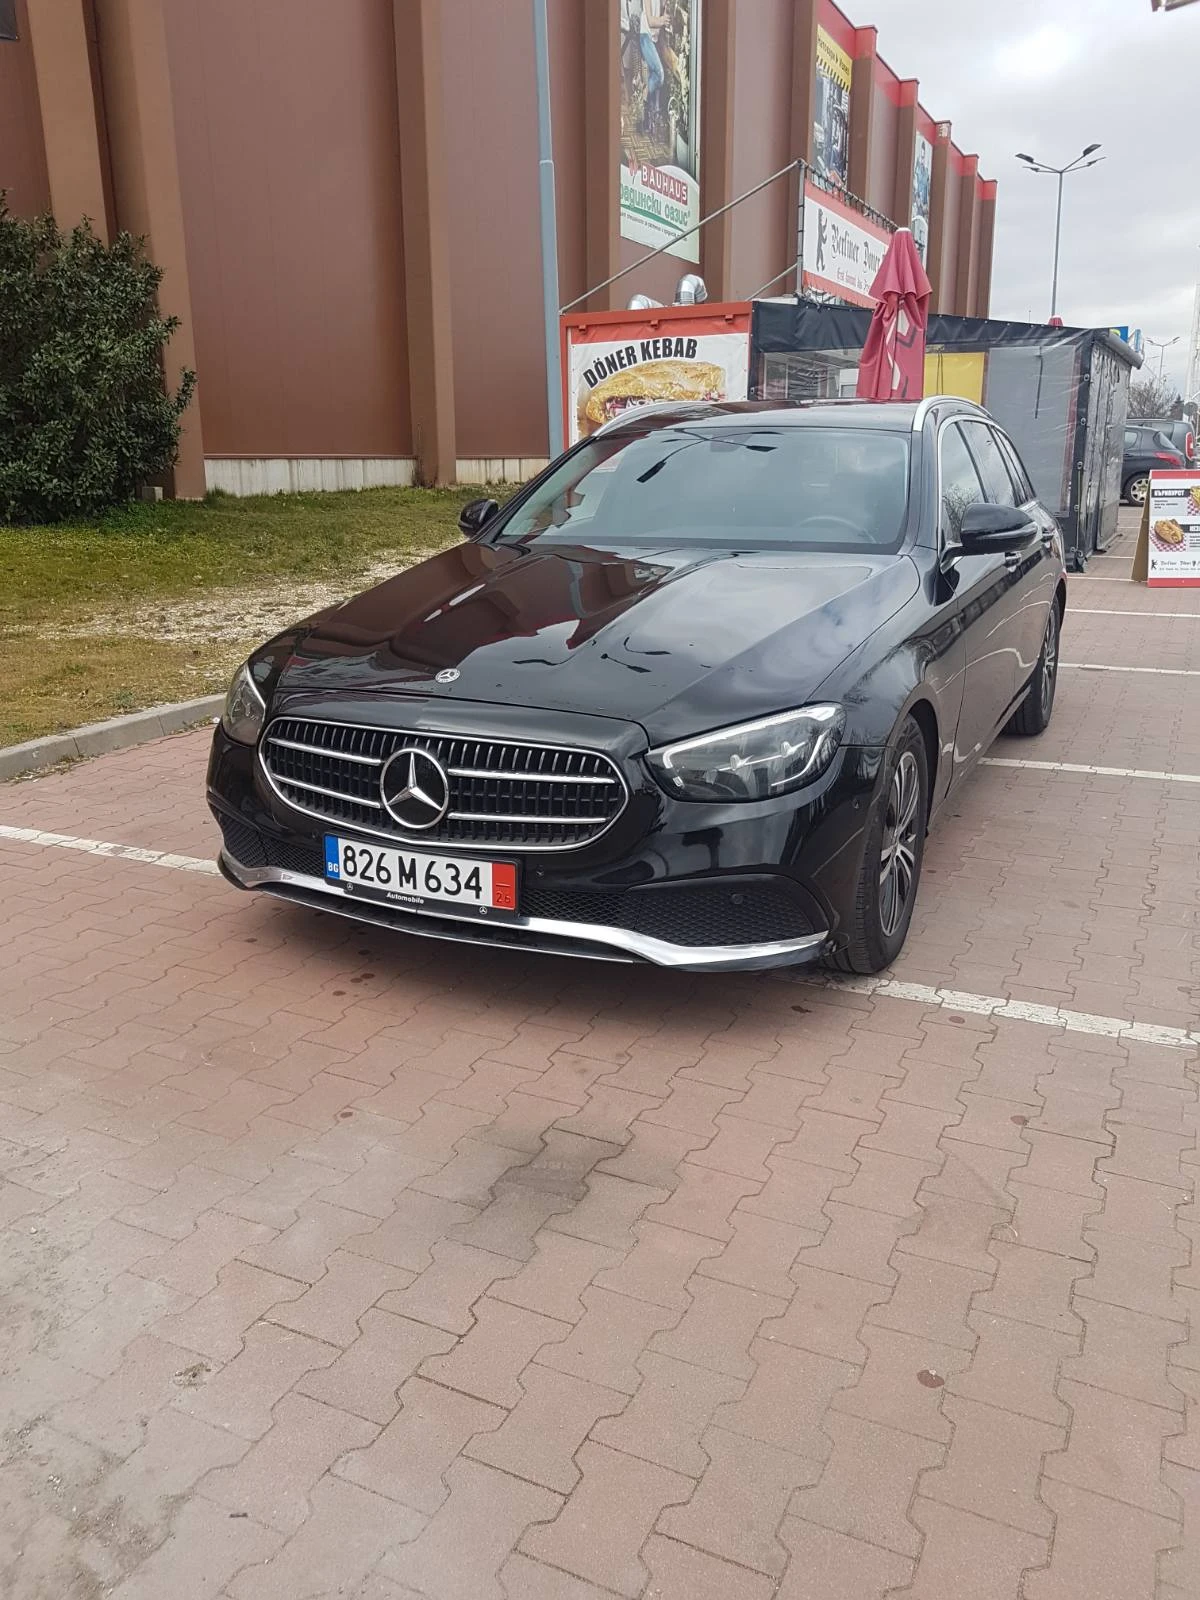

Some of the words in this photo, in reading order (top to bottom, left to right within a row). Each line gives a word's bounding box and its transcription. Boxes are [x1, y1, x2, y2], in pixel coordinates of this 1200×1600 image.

[642, 165, 687, 201] BAUHAUS
[582, 345, 638, 388] DÖNER
[640, 337, 698, 361] KEBAB
[327, 861, 339, 873] BG
[343, 845, 392, 884] 826
[398, 855, 417, 890] M
[424, 860, 483, 900] 634
[386, 892, 425, 904] Automobile
